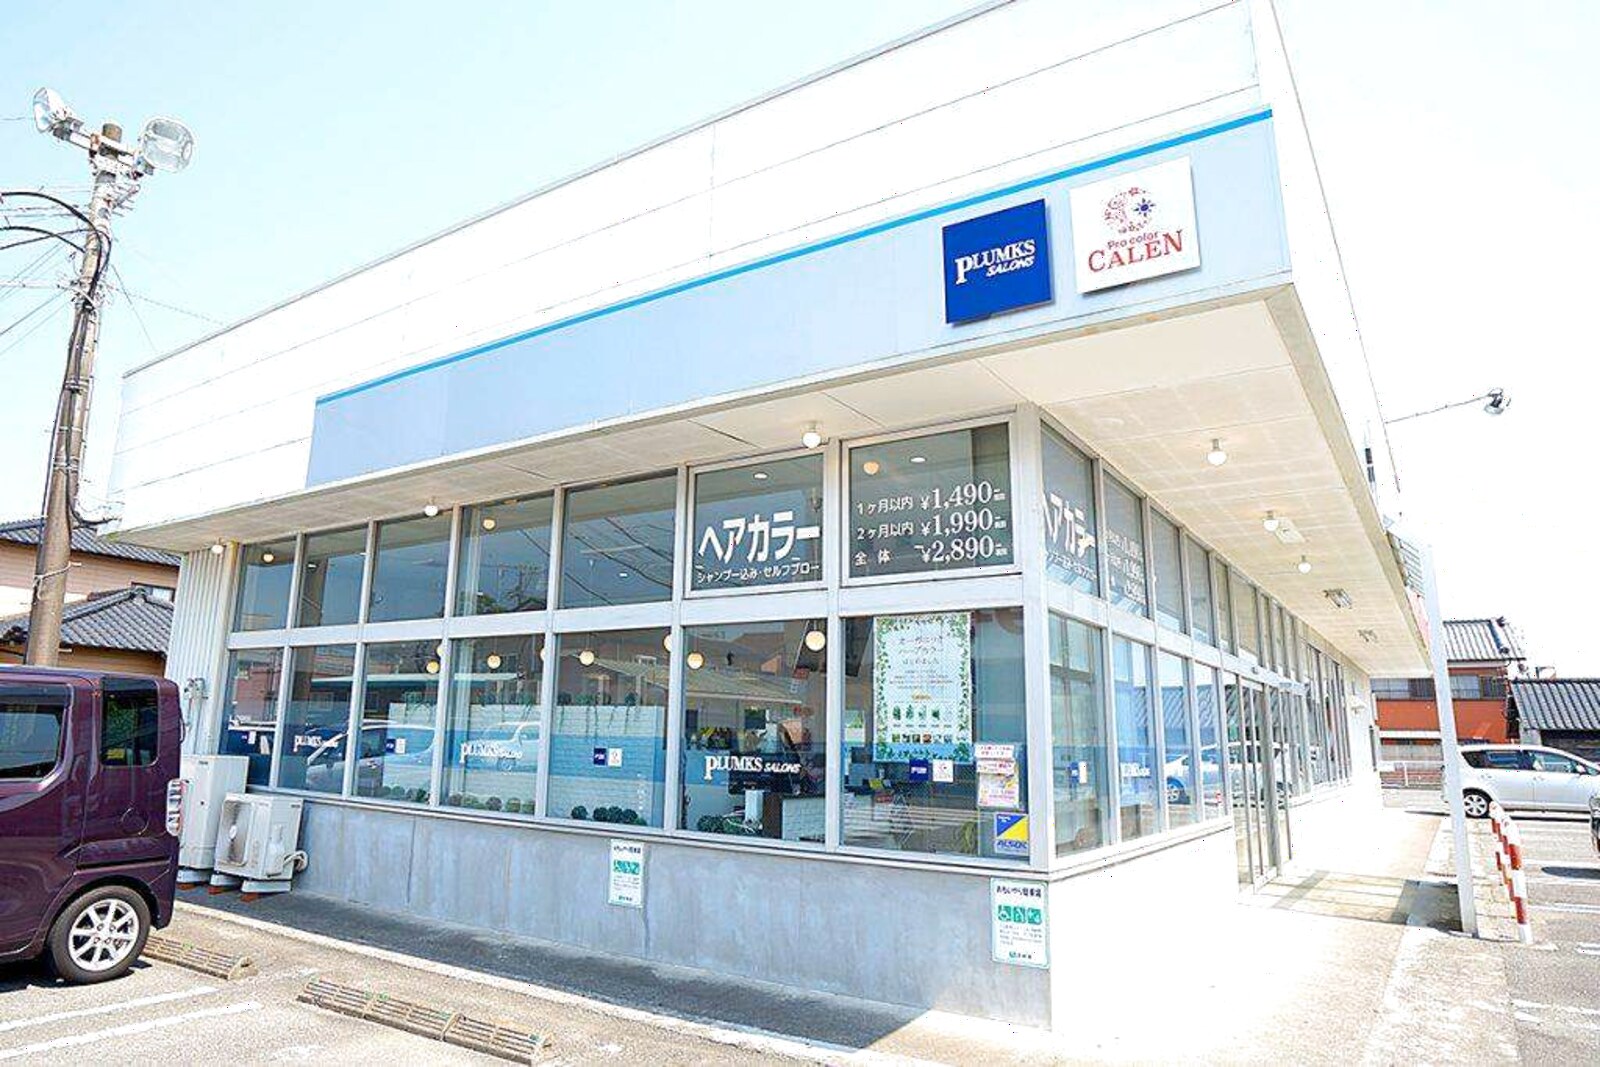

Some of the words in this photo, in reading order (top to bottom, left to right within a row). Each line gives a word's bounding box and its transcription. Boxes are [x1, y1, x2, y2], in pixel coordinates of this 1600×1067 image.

[1088, 229, 1183, 272] CALEN
[1108, 239, 1127, 249] Pro
[1129, 232, 1158, 244] color
[955, 239, 1035, 285] PLUMKS
[986, 256, 1035, 277] SALONS
[698, 510, 820, 564] ヘアカラー
[704, 755, 763, 780] PLUMKS
